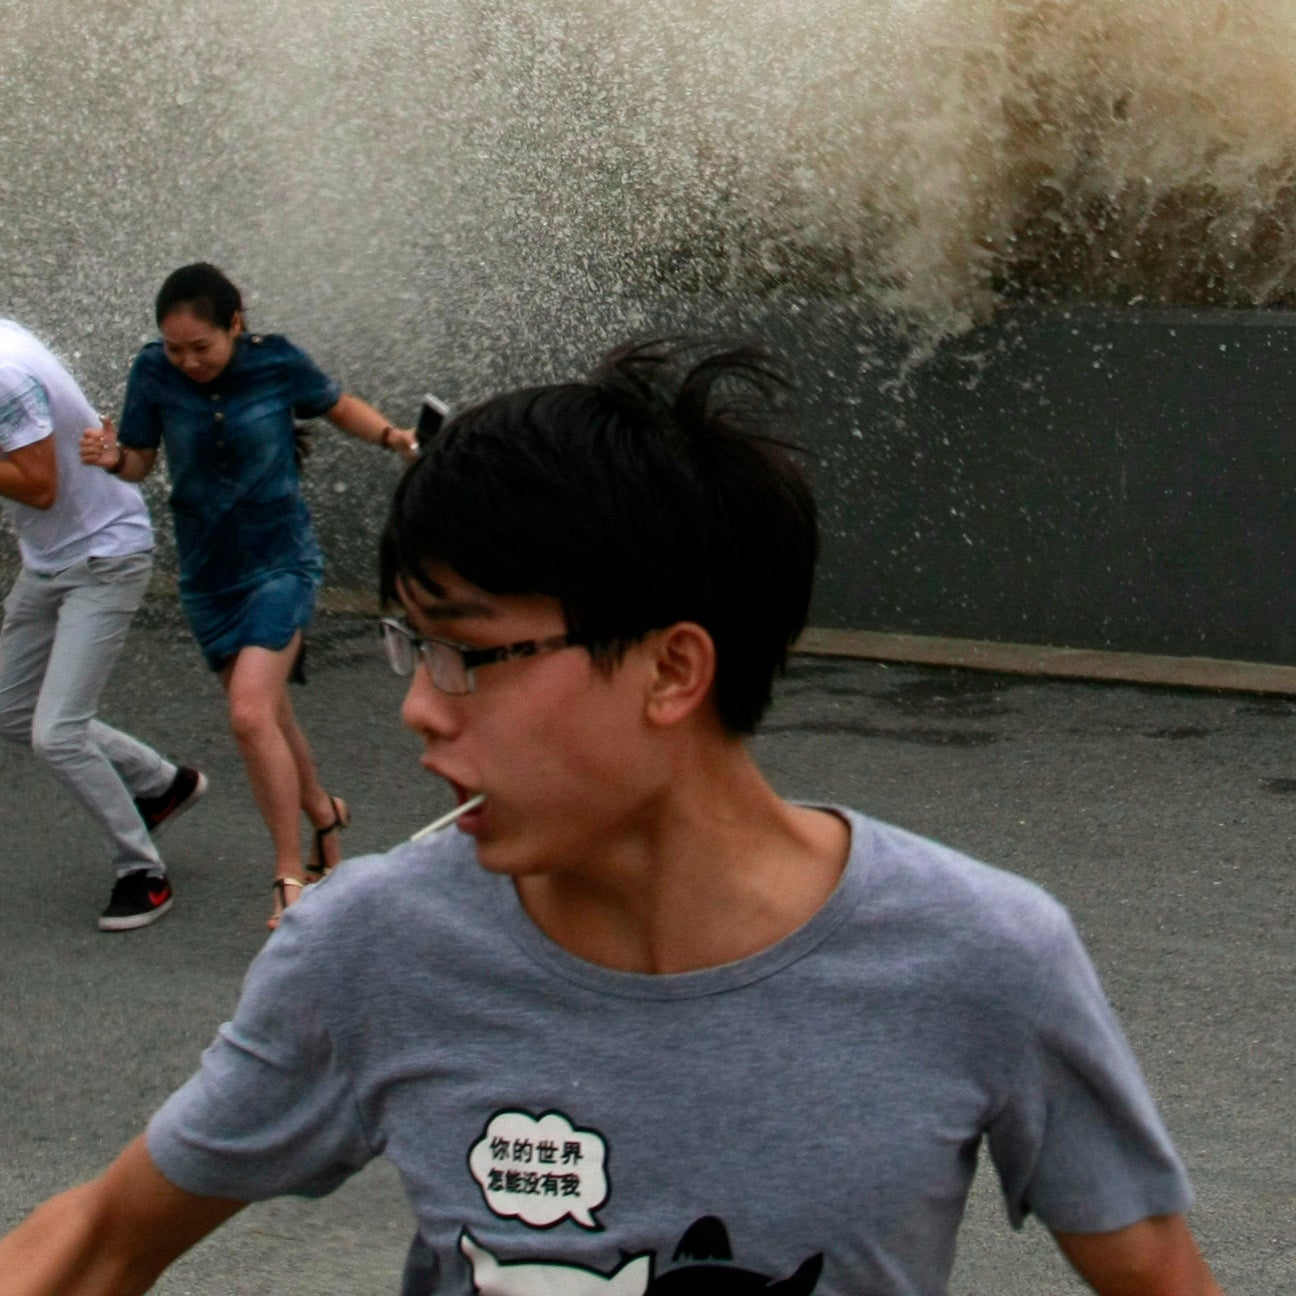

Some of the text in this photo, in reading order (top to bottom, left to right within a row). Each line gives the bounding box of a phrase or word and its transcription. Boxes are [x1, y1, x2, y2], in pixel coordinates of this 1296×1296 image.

[489, 1135, 584, 1165] 你的世界
[487, 1167, 581, 1197] 怎能没有我
